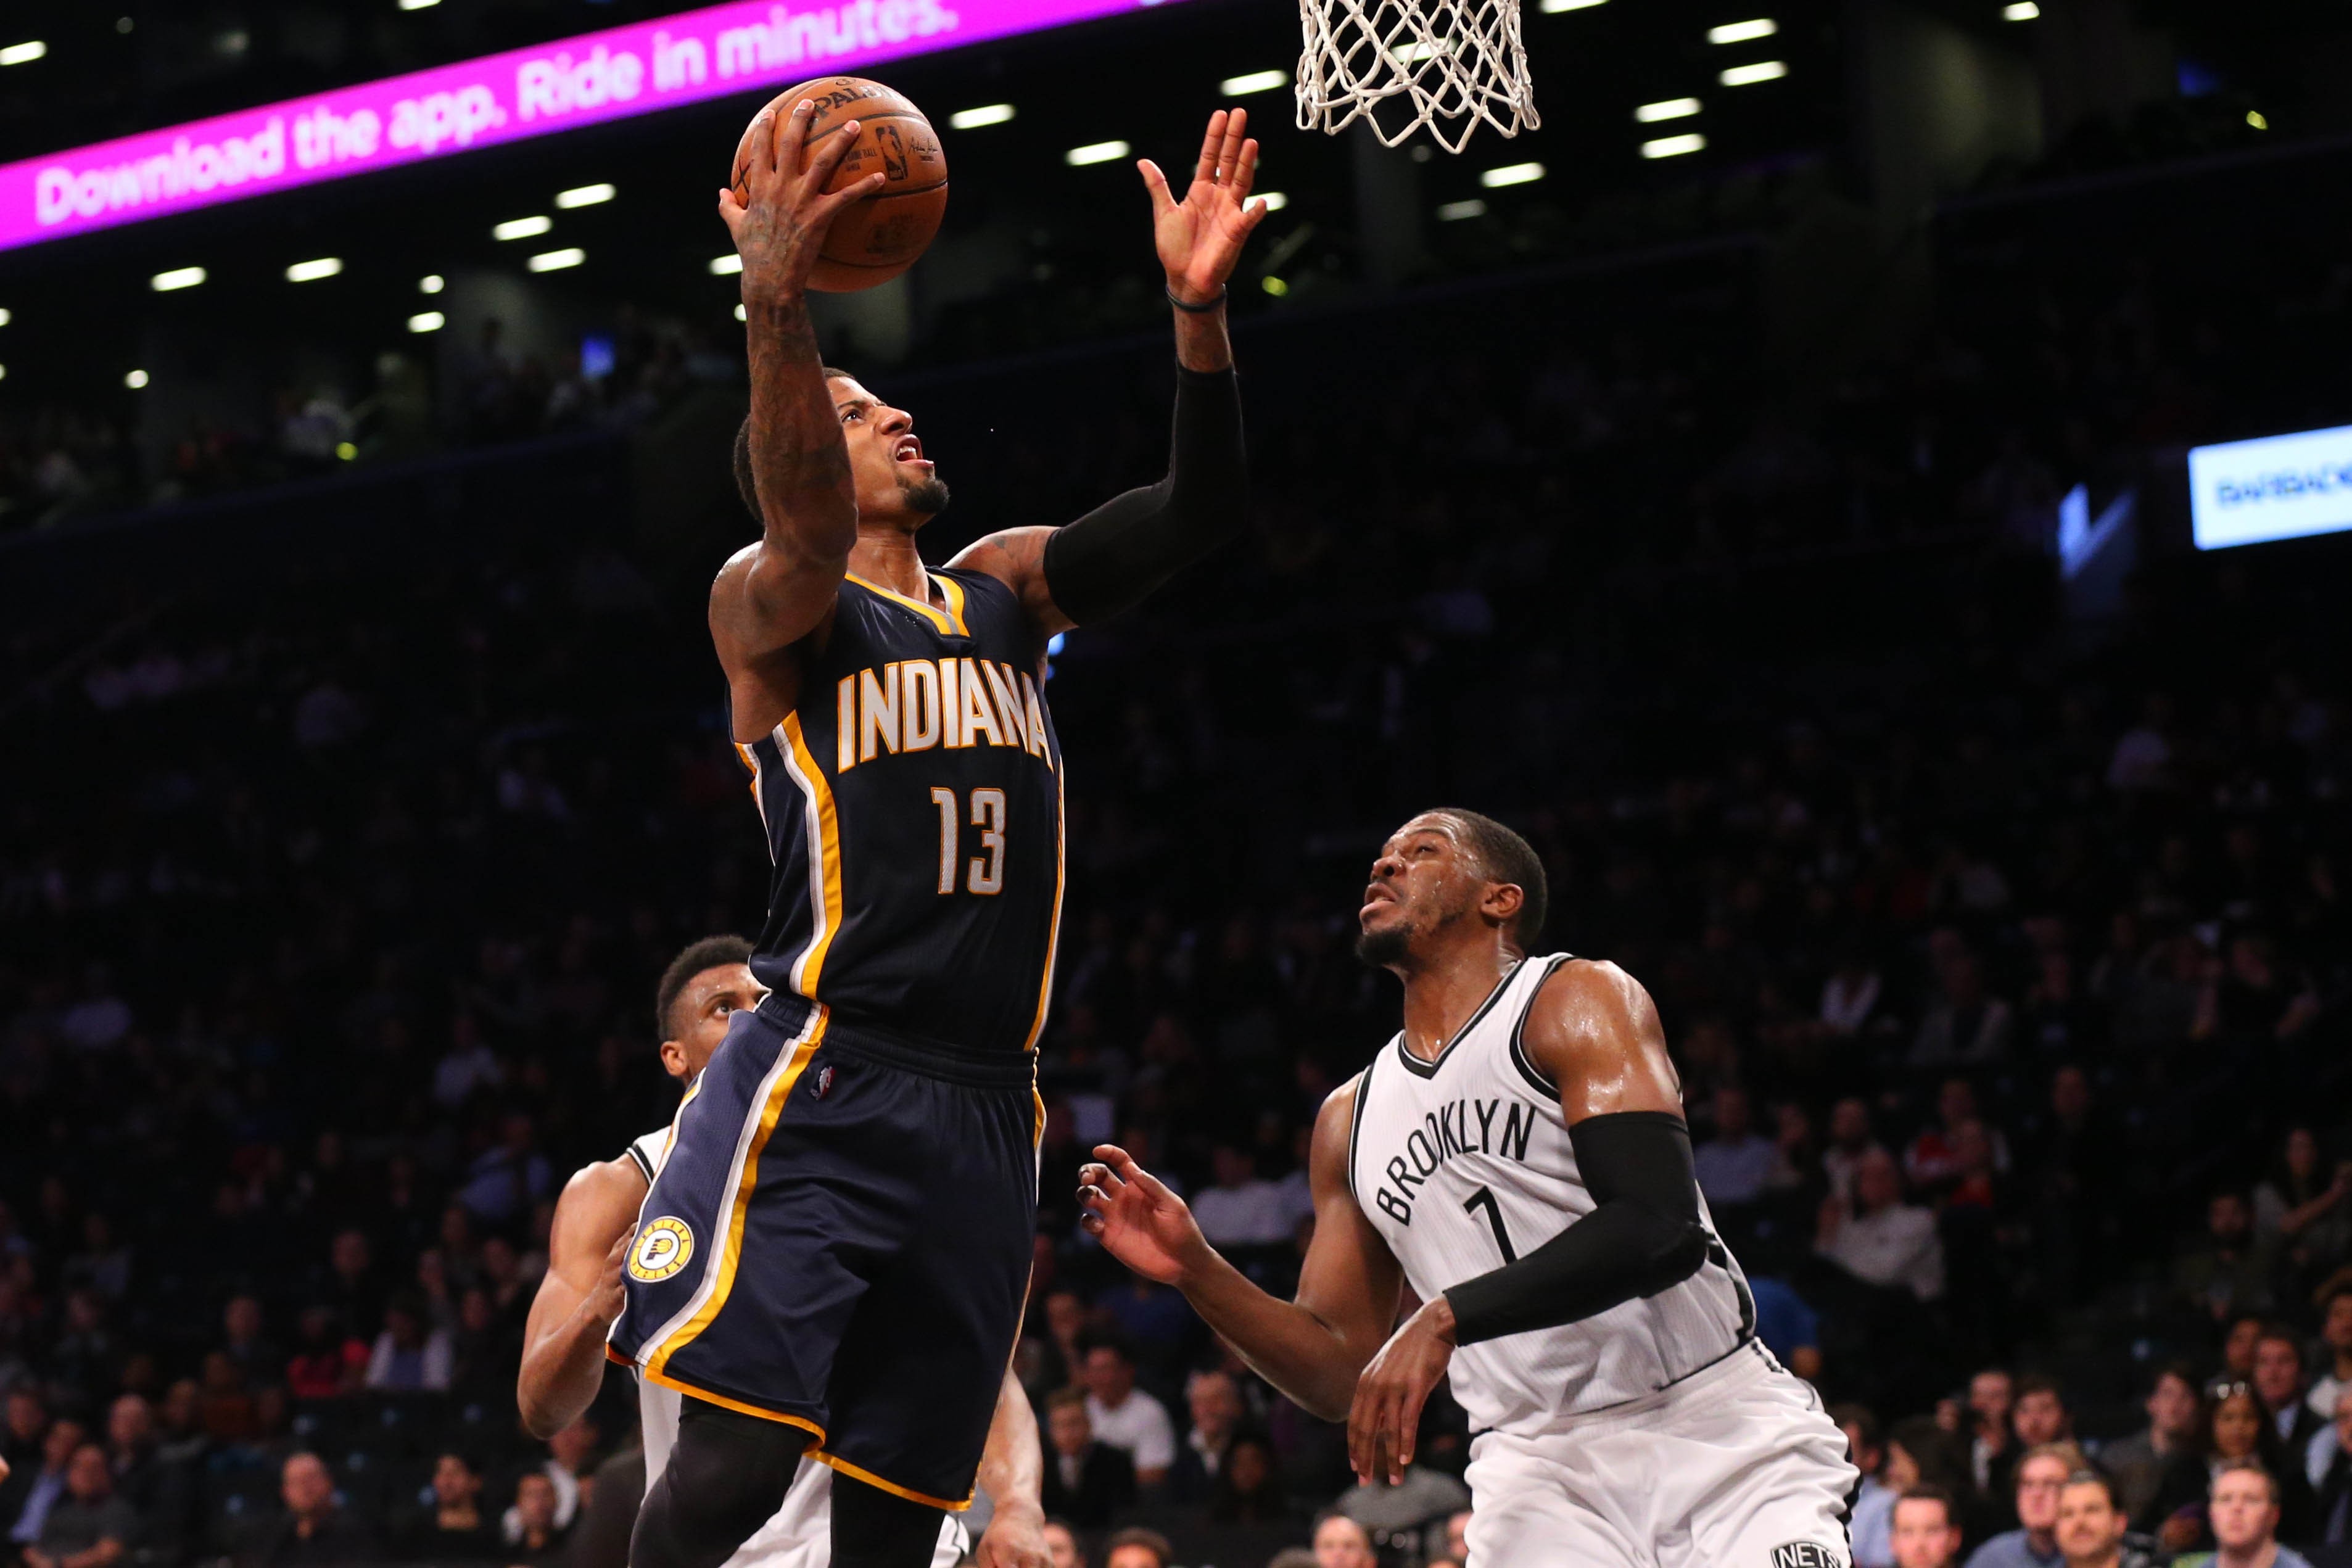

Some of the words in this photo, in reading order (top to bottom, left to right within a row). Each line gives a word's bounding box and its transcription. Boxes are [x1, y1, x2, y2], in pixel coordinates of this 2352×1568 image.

[36, 115, 285, 226] Download
[293, 104, 381, 169] the
[388, 83, 508, 155] app.
[517, 44, 645, 122] Ride
[651, 30, 708, 92] in
[716, 0, 960, 79] minutes.
[838, 658, 1054, 774] INDIANA
[930, 787, 1006, 895] 13
[1376, 1099, 1536, 1226] BROOKLYN
[1463, 1186, 1518, 1266] 7
[1778, 1543, 1839, 1568] NETS
